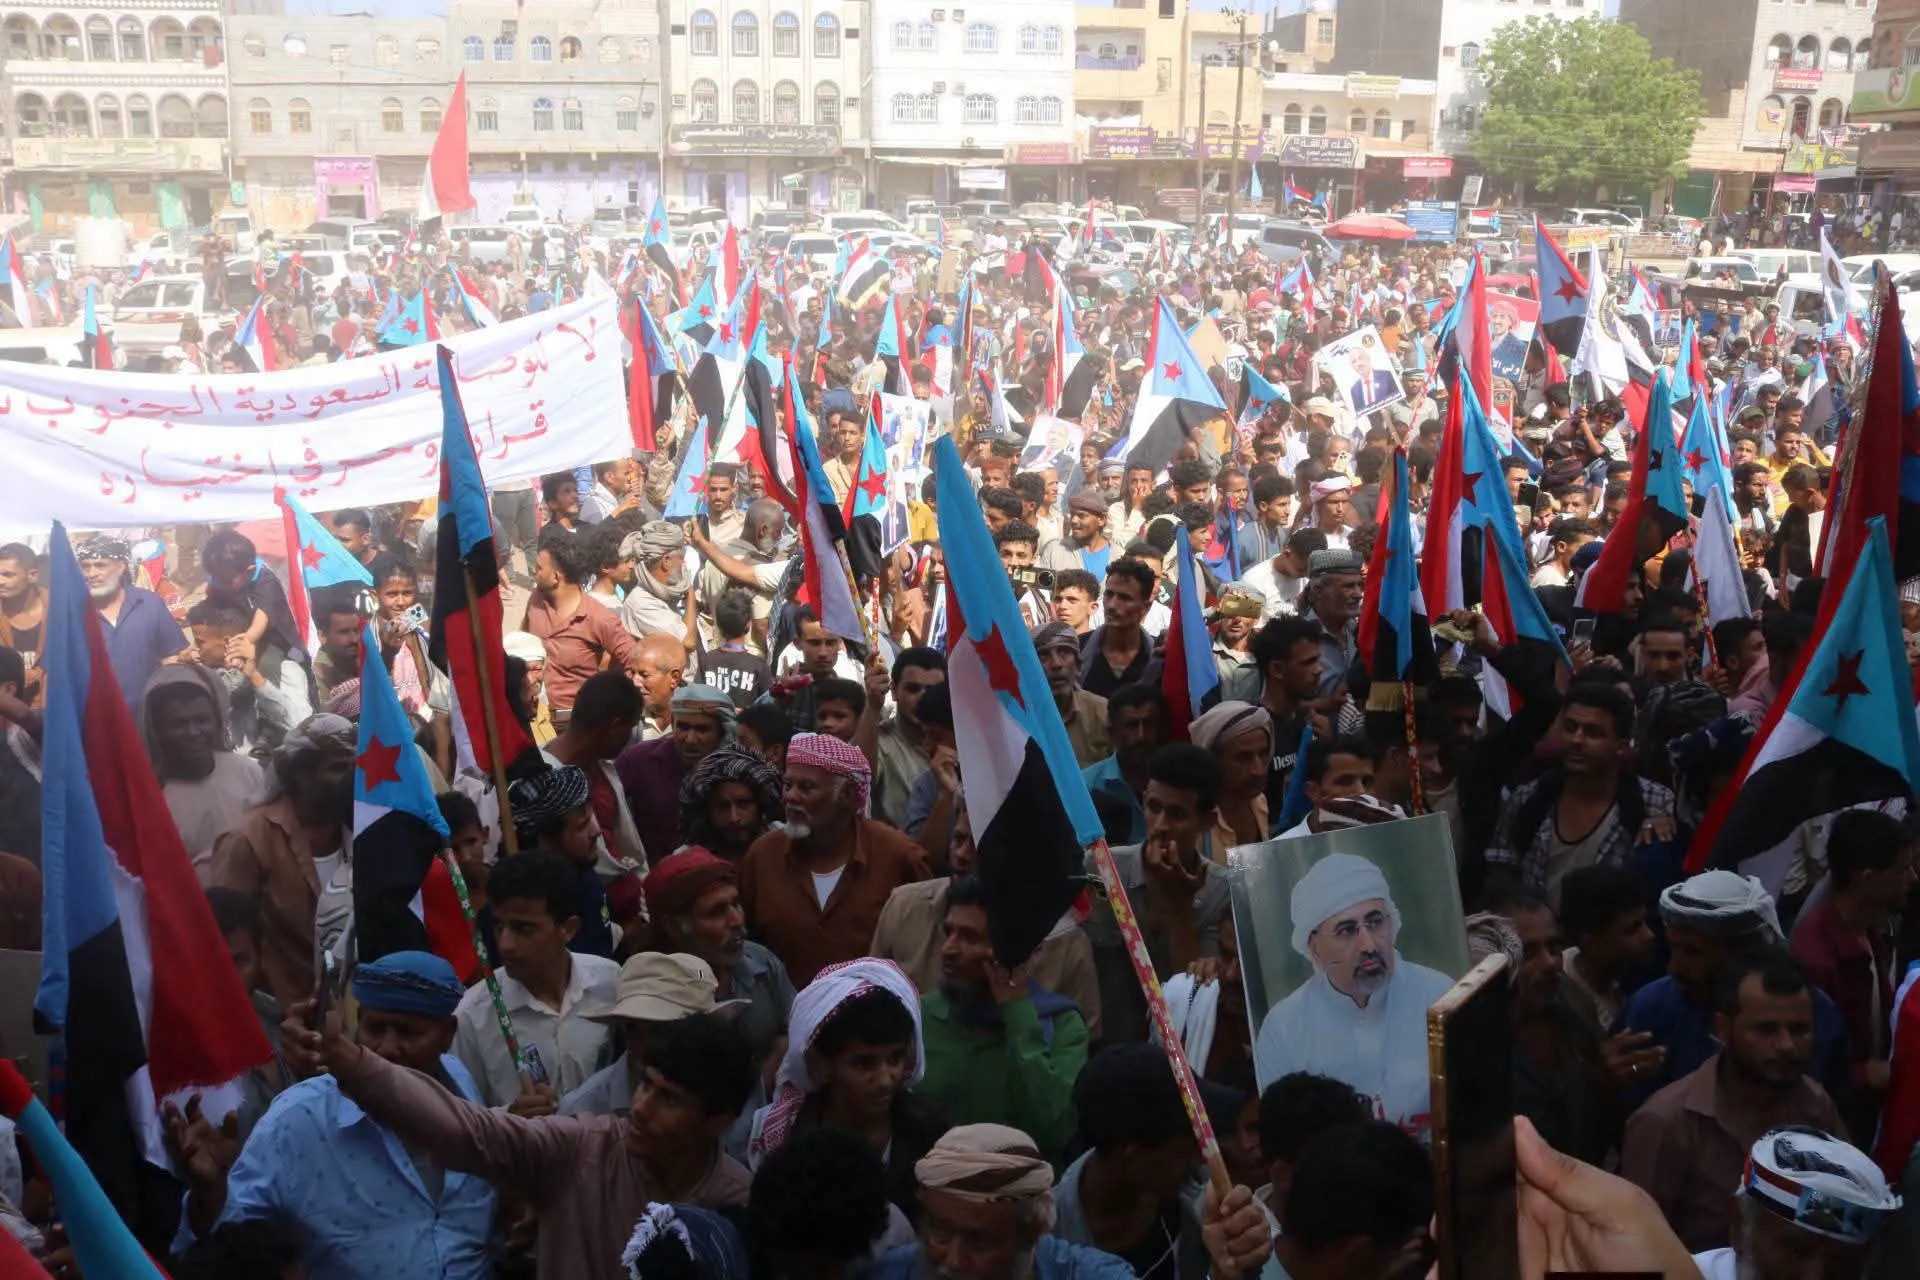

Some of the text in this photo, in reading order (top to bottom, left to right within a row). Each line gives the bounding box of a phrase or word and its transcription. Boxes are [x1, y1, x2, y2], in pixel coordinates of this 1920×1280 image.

[556, 316, 598, 362] لا
[27, 384, 222, 435] الجنوب
[233, 362, 401, 422] السعودية
[99, 444, 279, 504] اختياره
[288, 436, 324, 498] في
